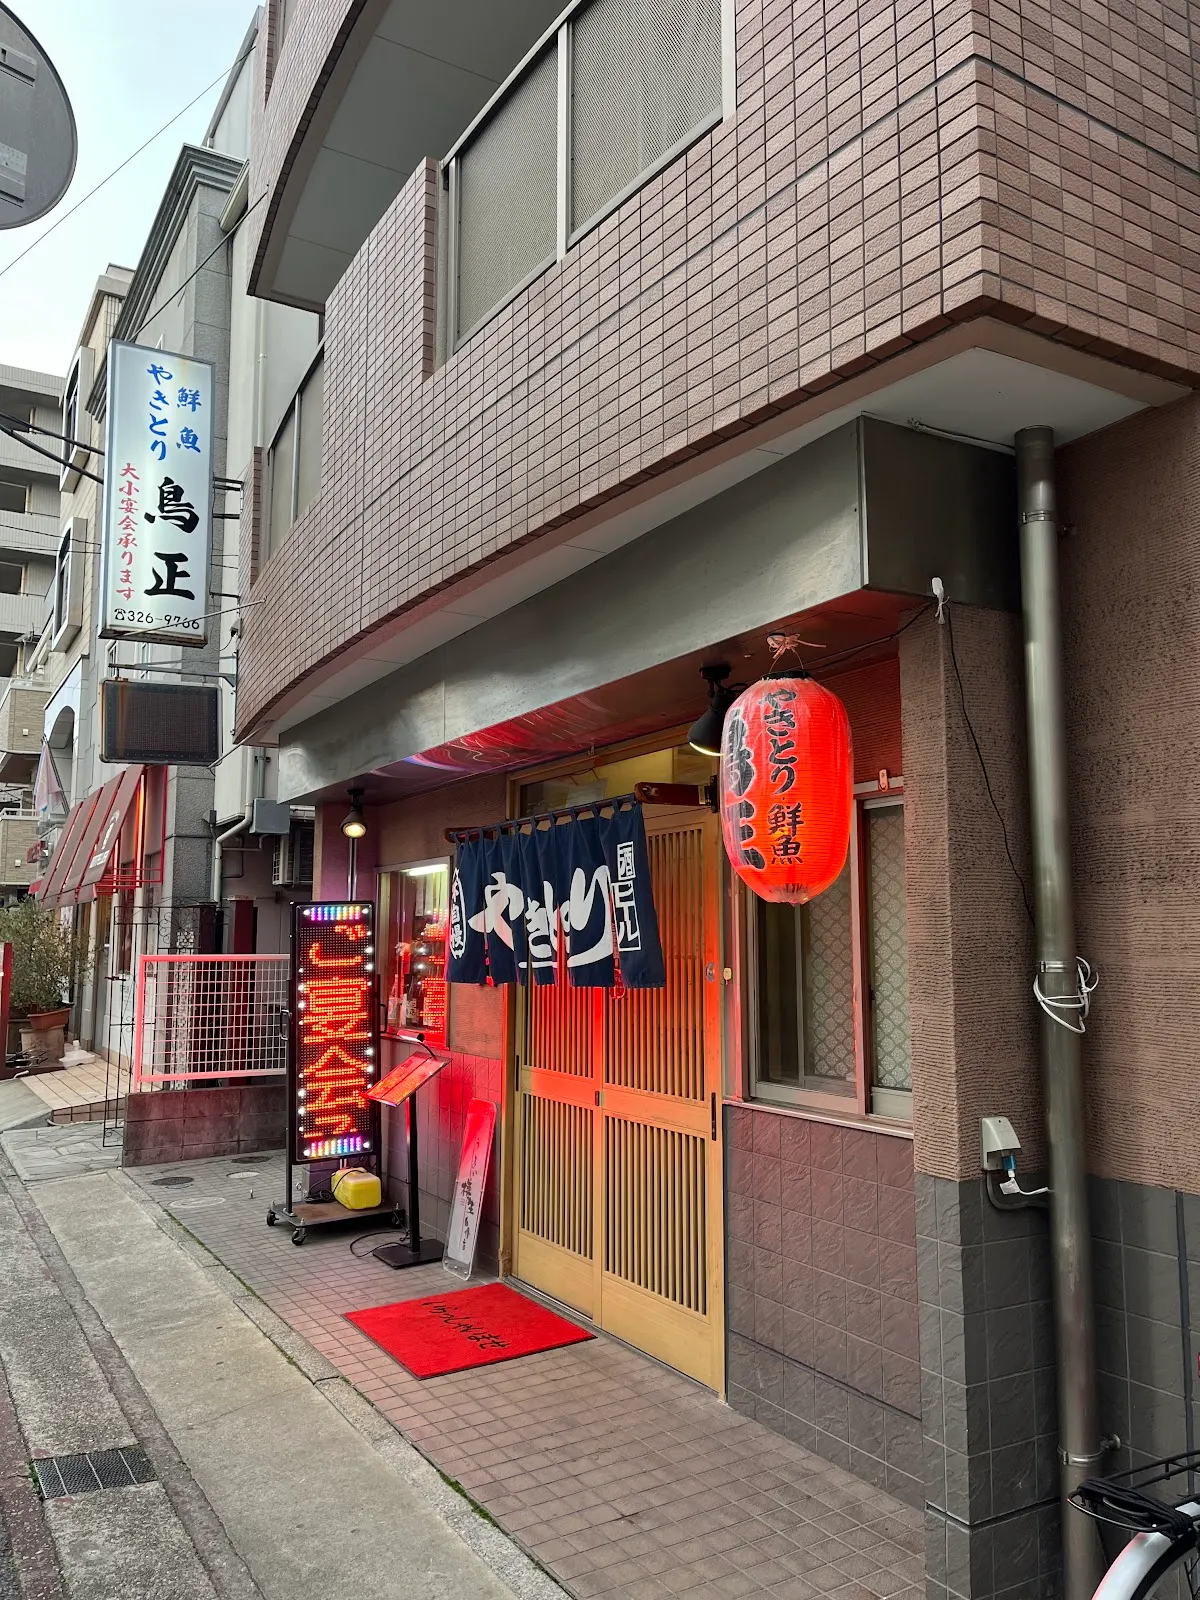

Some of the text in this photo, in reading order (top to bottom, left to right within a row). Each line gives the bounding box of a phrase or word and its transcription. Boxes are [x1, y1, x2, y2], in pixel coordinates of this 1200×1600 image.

[147, 363, 173, 461] やきとり
[177, 387, 202, 453] 鮮魚
[116, 463, 139, 601] 大小宴会承ります
[144, 476, 200, 600] 鳥正
